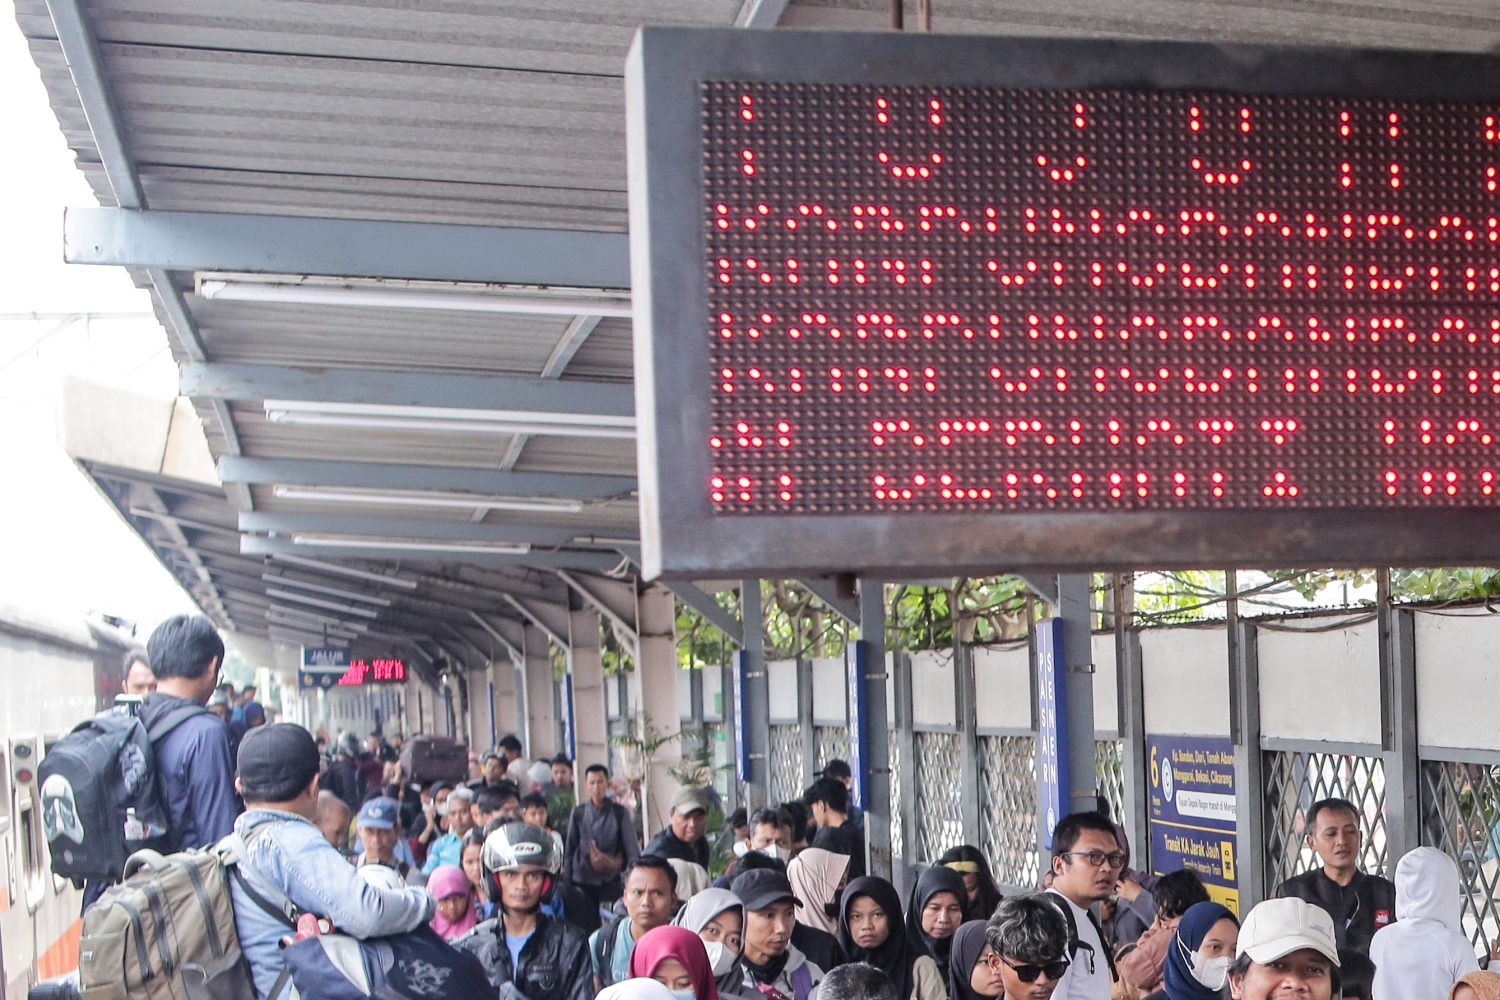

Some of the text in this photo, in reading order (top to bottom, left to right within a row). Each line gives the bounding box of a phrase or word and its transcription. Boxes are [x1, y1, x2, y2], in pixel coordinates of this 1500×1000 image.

[1039, 652, 1049, 778] PASAR
[1047, 652, 1057, 784] SENEN
[1150, 745, 1159, 788] 6
